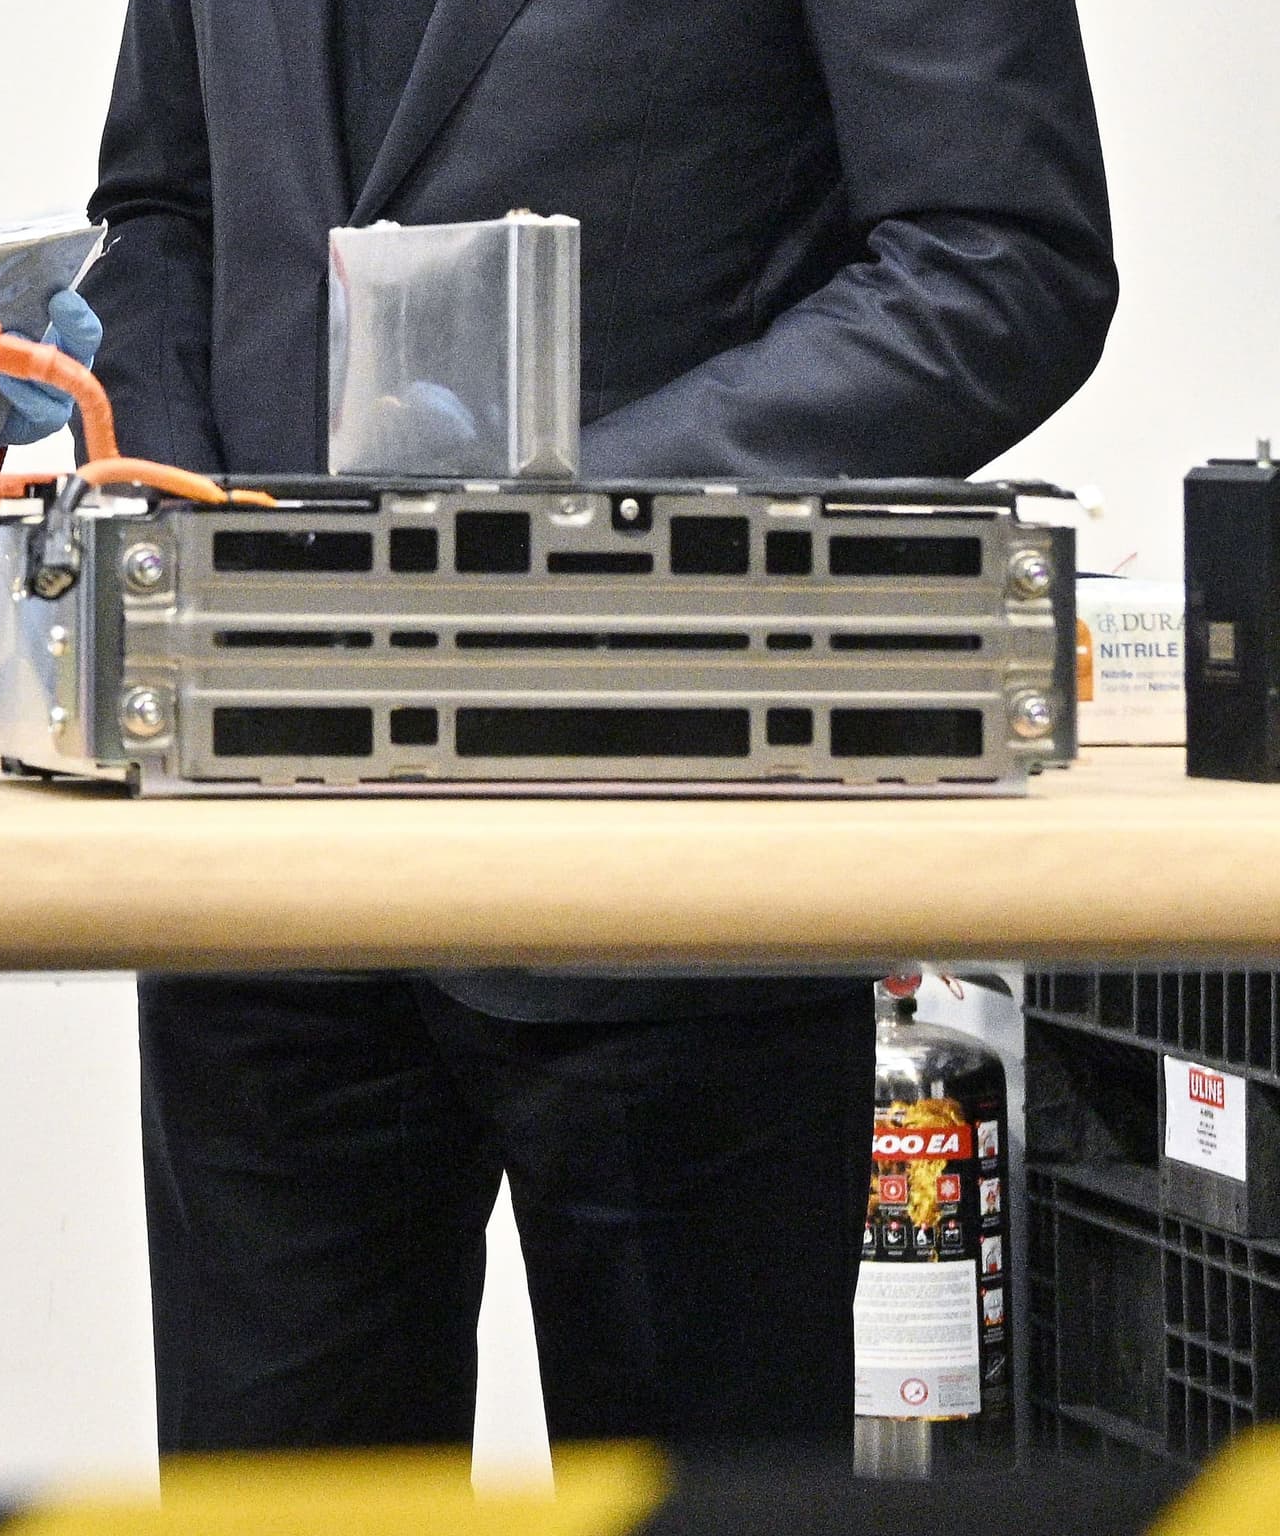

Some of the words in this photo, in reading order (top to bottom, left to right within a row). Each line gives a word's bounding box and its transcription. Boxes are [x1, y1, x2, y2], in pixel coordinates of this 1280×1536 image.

[1100, 643, 1178, 658] NITRILE
[1190, 1072, 1223, 1105] ULINE
[926, 1133, 959, 1154] EA
